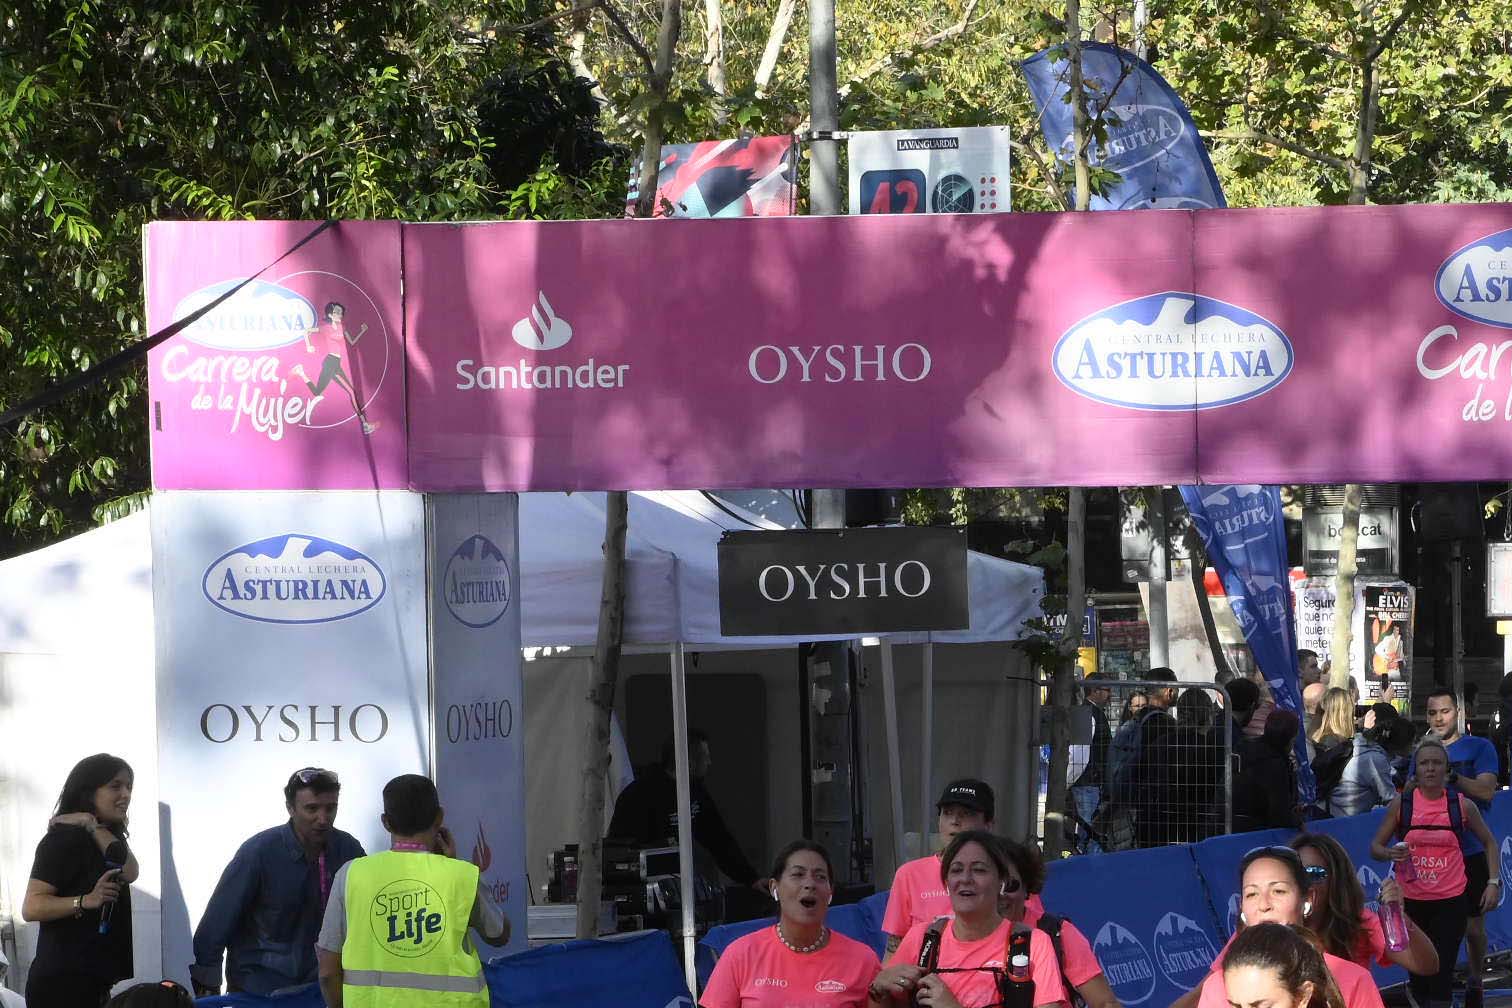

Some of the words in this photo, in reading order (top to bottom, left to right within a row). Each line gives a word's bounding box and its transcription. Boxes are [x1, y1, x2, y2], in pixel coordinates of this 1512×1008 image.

[1191, 330, 1267, 344] LECHERA
[161, 344, 280, 383] Carrera
[456, 358, 631, 391] Santander
[748, 342, 932, 384] OYSHO
[1072, 337, 1274, 380] ASTURIANA
[230, 379, 325, 441] Mujer
[1462, 385, 1497, 423] de
[216, 567, 373, 601] ASTURIANA
[244, 565, 302, 575] CENTRAL
[308, 565, 367, 575] LECHERA
[758, 560, 931, 602] OYSHO
[1378, 595, 1409, 608] ELVIS
[199, 702, 389, 745] OYSHO
[446, 698, 513, 745] OYSHO
[375, 886, 432, 917] Sport
[386, 907, 443, 945] Life
